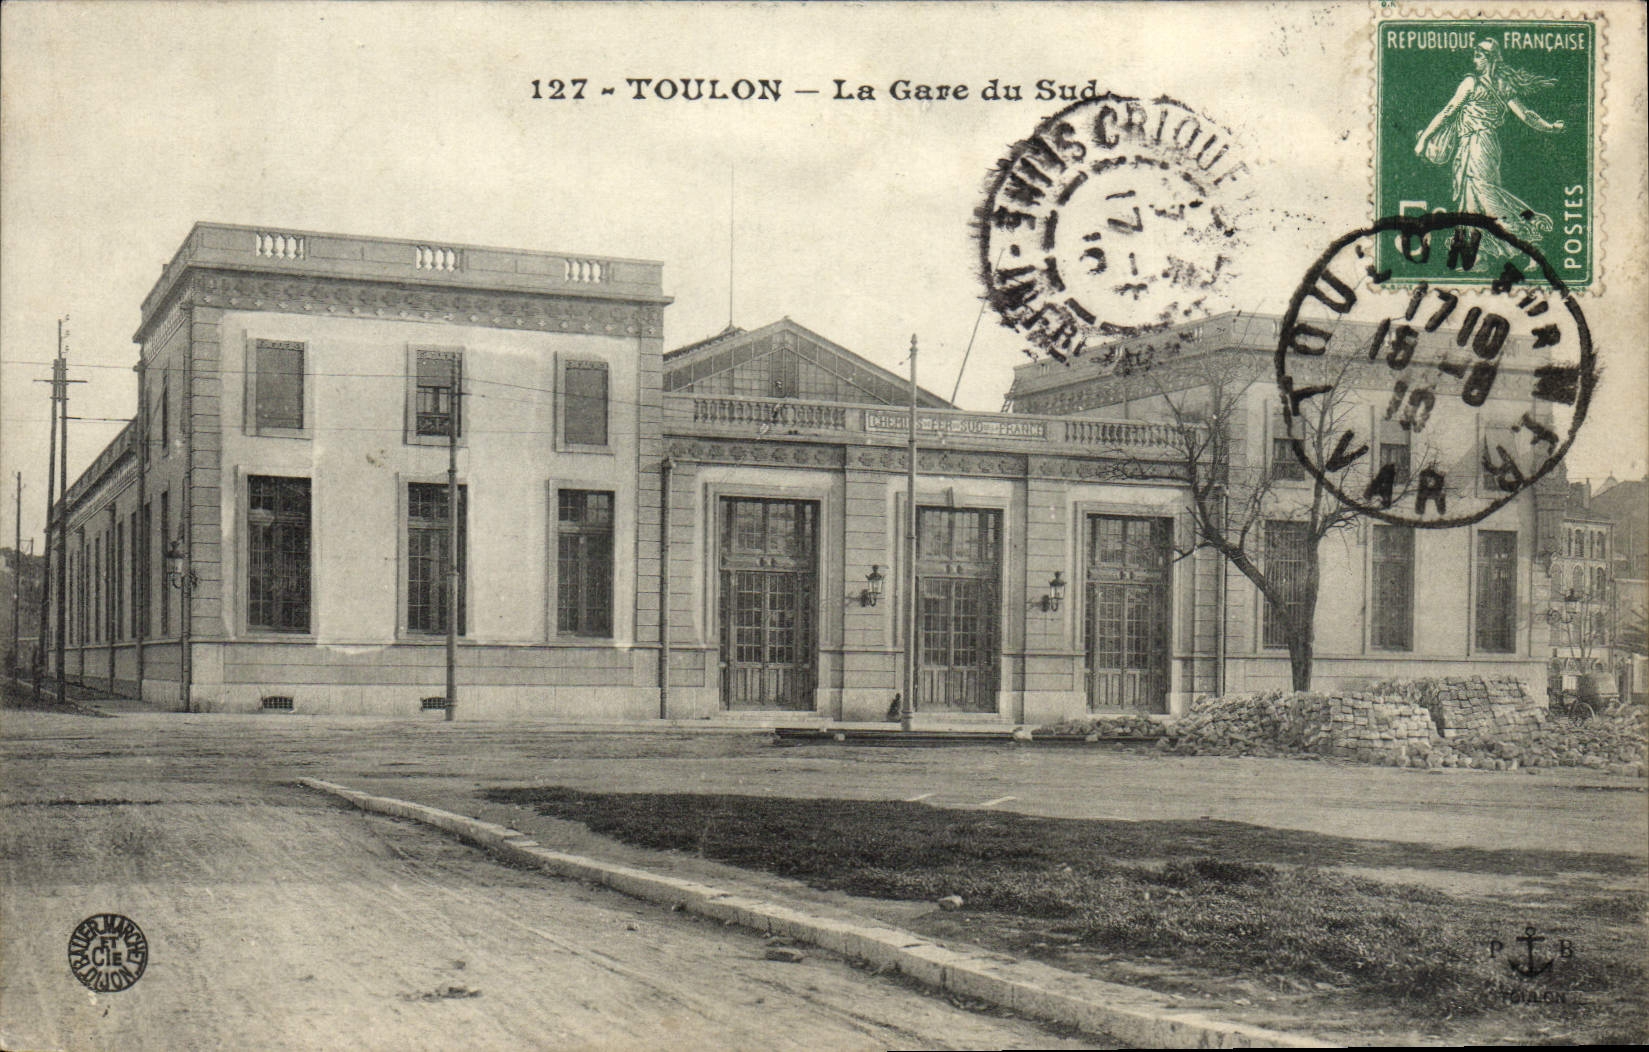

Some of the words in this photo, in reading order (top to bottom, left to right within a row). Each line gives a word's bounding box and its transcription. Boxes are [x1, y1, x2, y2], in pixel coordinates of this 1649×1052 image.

[1503, 32, 1585, 52] FRANÇAISE
[1564, 184, 1584, 269] POSTES
[960, 420, 983, 434] SUD
[1324, 429, 1447, 516] VAR
